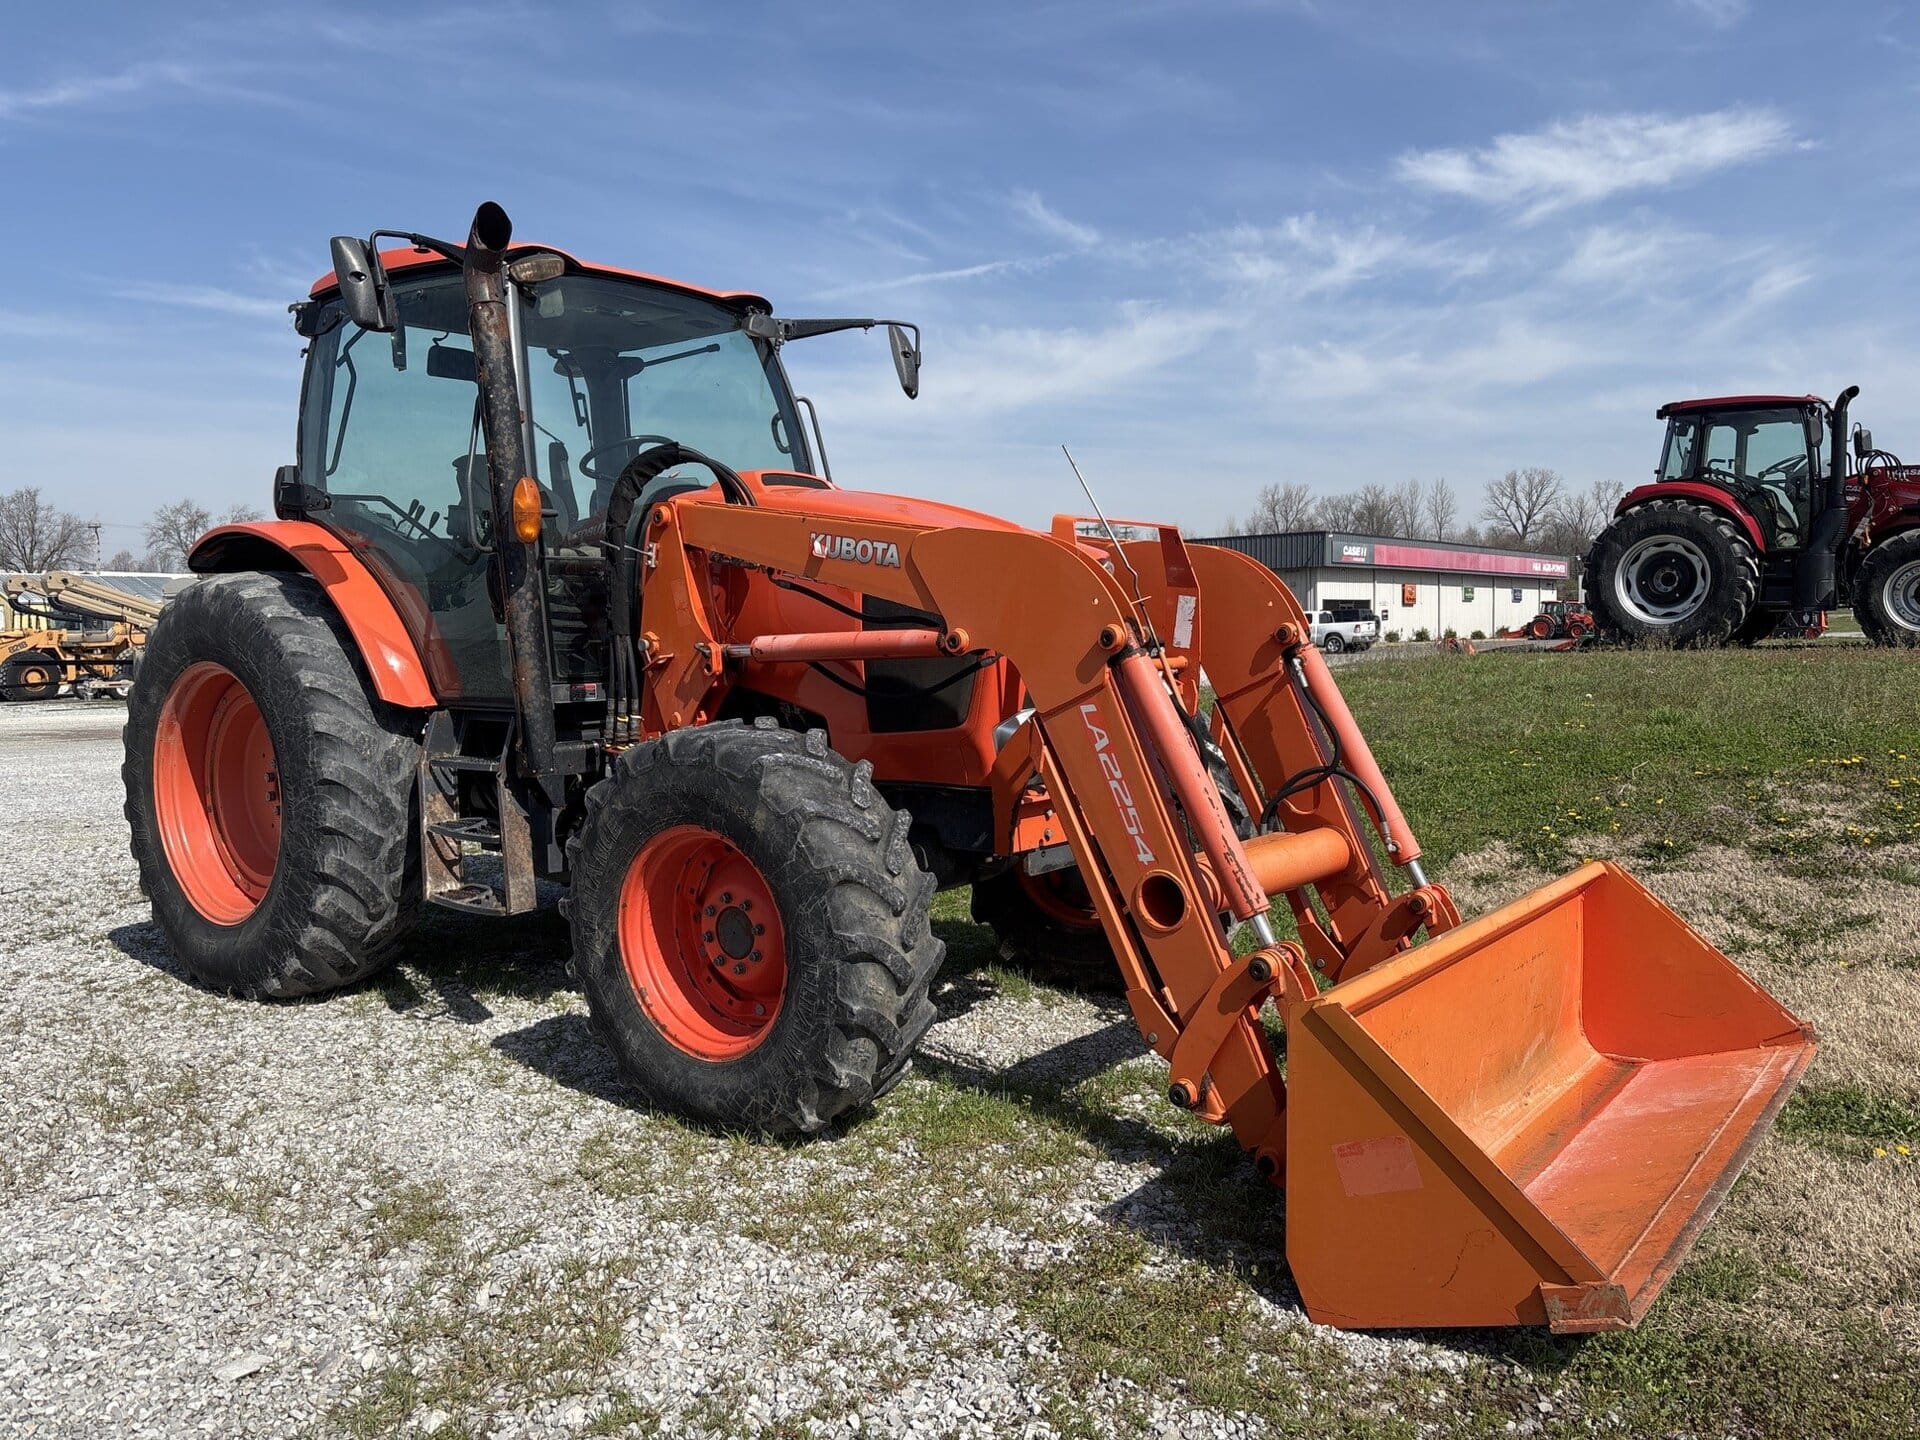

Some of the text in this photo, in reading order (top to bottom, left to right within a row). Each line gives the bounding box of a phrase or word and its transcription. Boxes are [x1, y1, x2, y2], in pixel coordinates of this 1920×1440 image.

[810, 532, 901, 568] KUBOTA
[1343, 545, 1361, 557] CASE
[1080, 704, 1156, 866] LA2254
